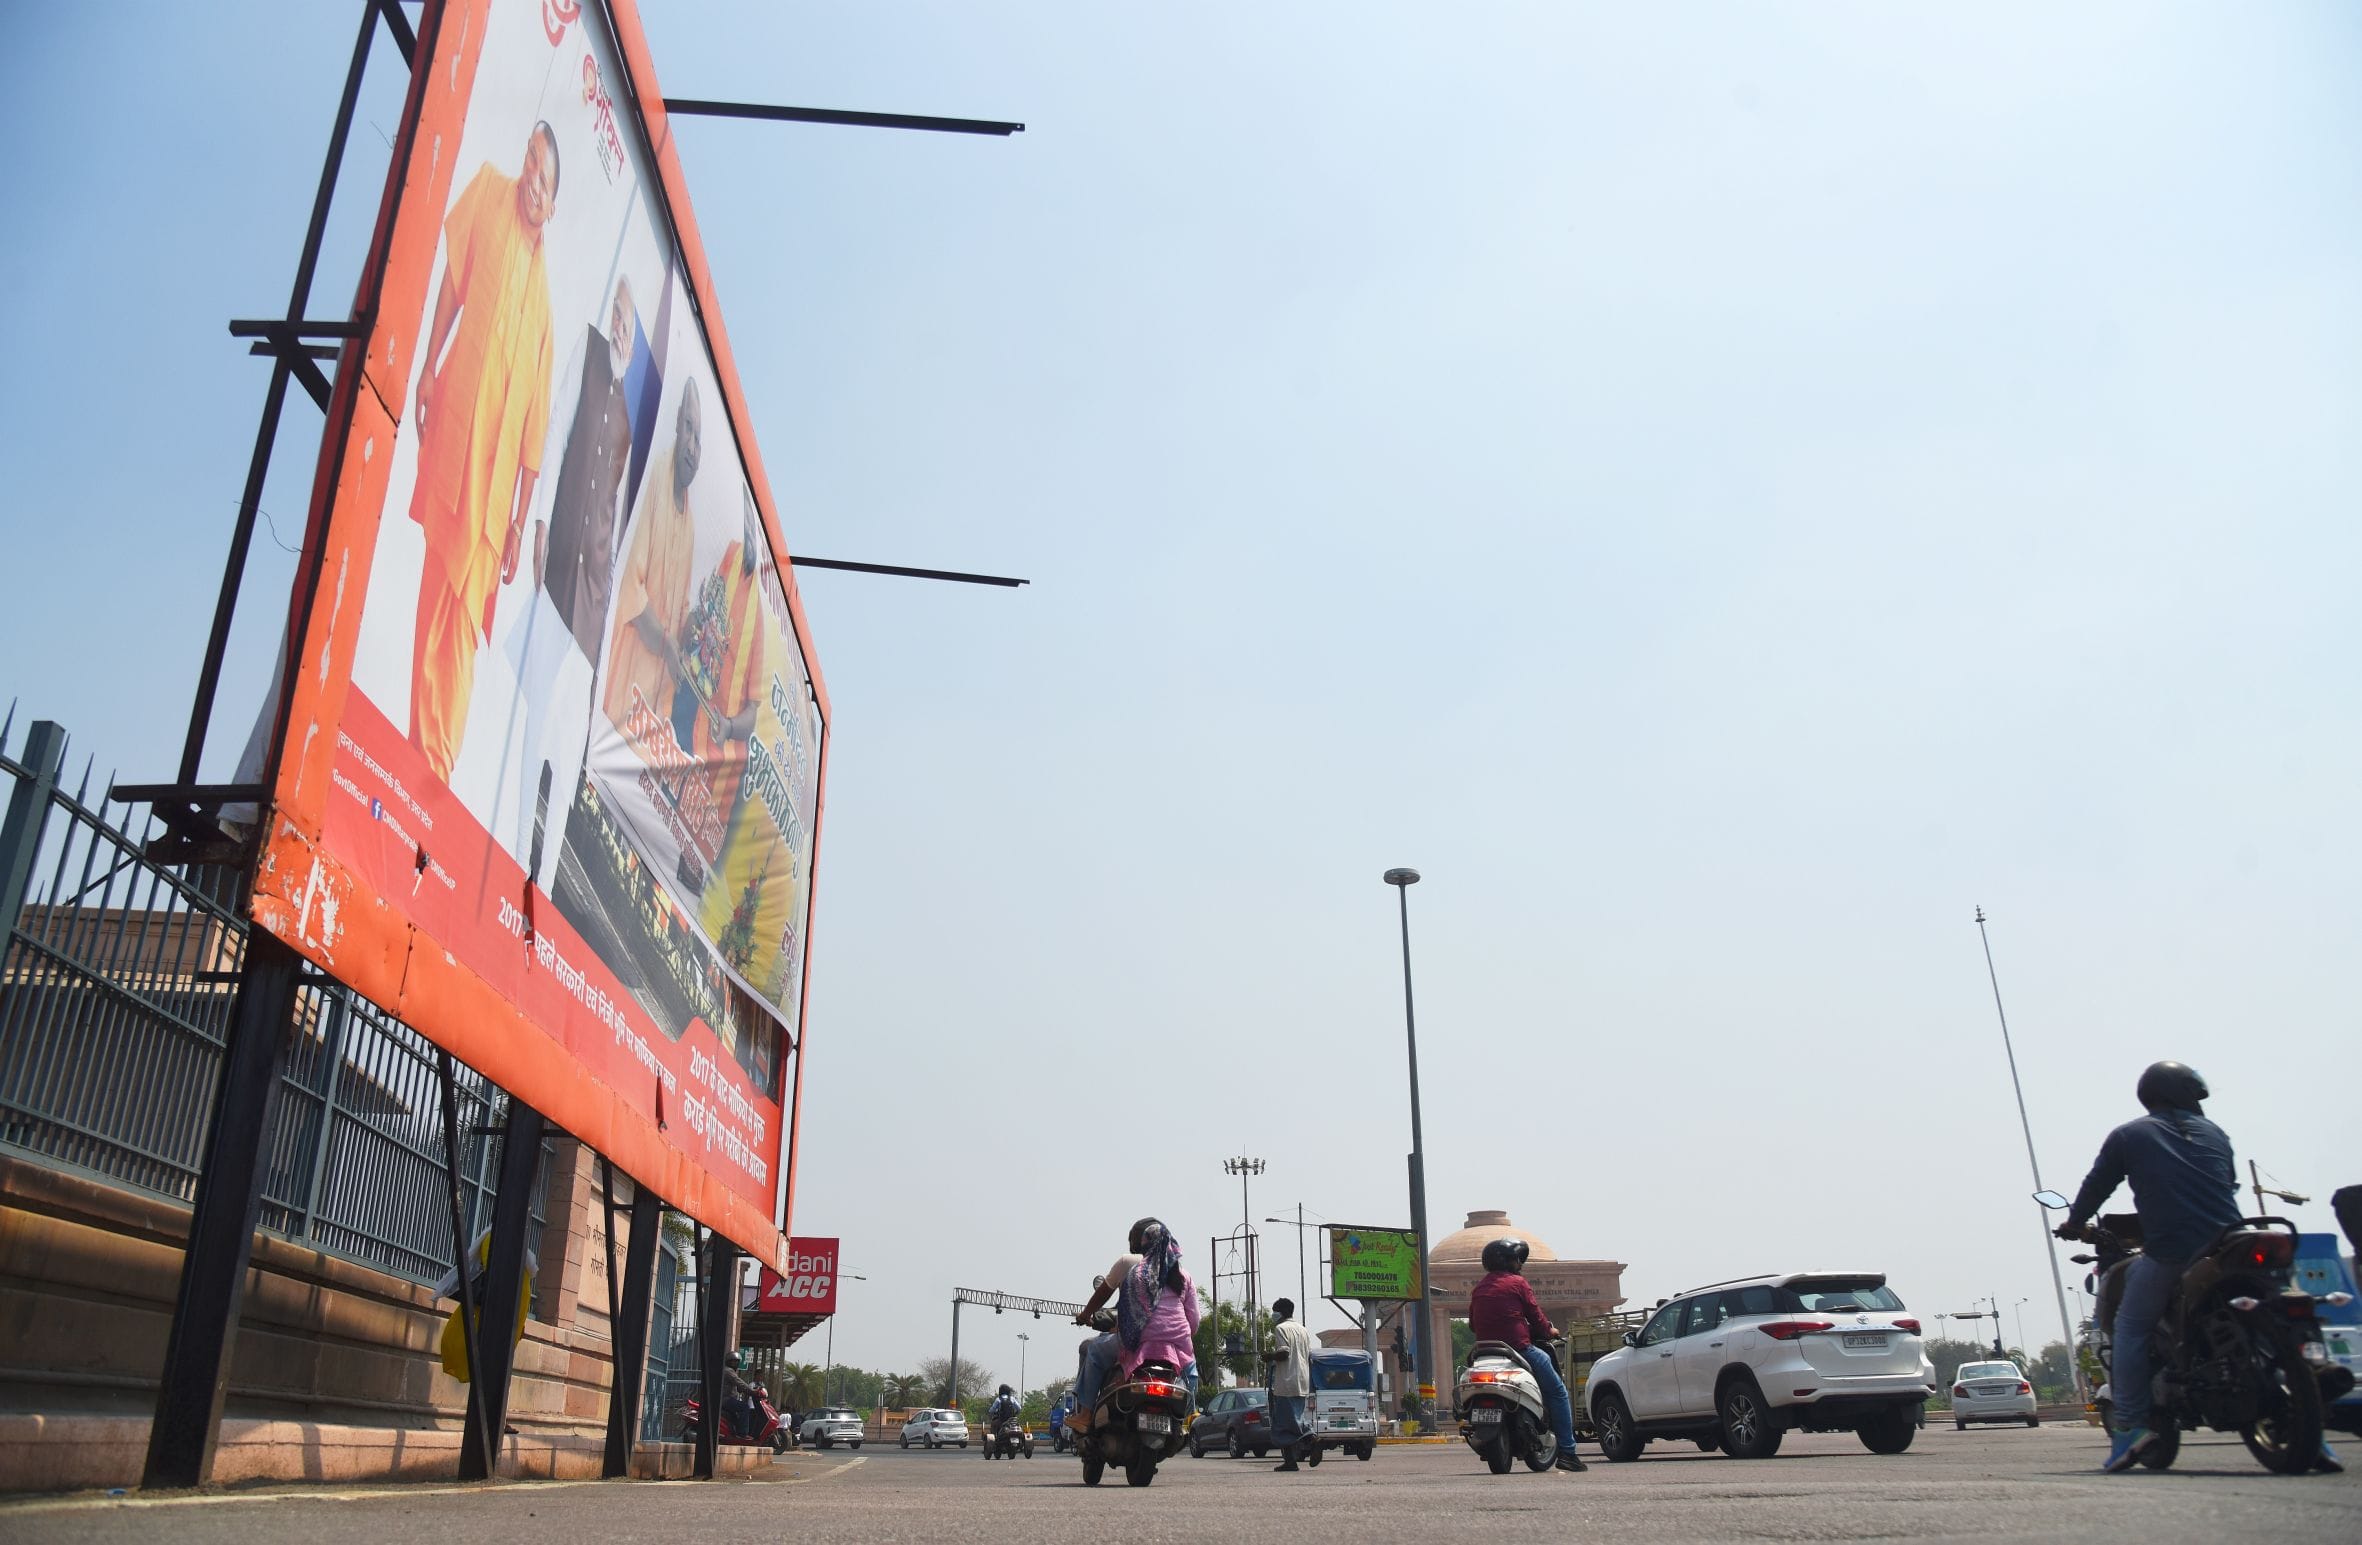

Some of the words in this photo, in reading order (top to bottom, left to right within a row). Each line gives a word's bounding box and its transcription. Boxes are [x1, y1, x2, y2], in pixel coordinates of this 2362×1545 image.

[498, 896, 523, 938] 2017
[535, 930, 556, 973] पहले
[556, 954, 585, 1003] सरकारी
[586, 984, 598, 1015] एवं
[598, 990, 614, 1029] निजी
[690, 1045, 709, 1086] 2017
[684, 1089, 706, 1136] कराई
[788, 1250, 833, 1273] dani
[768, 1276, 831, 1299] ACC
